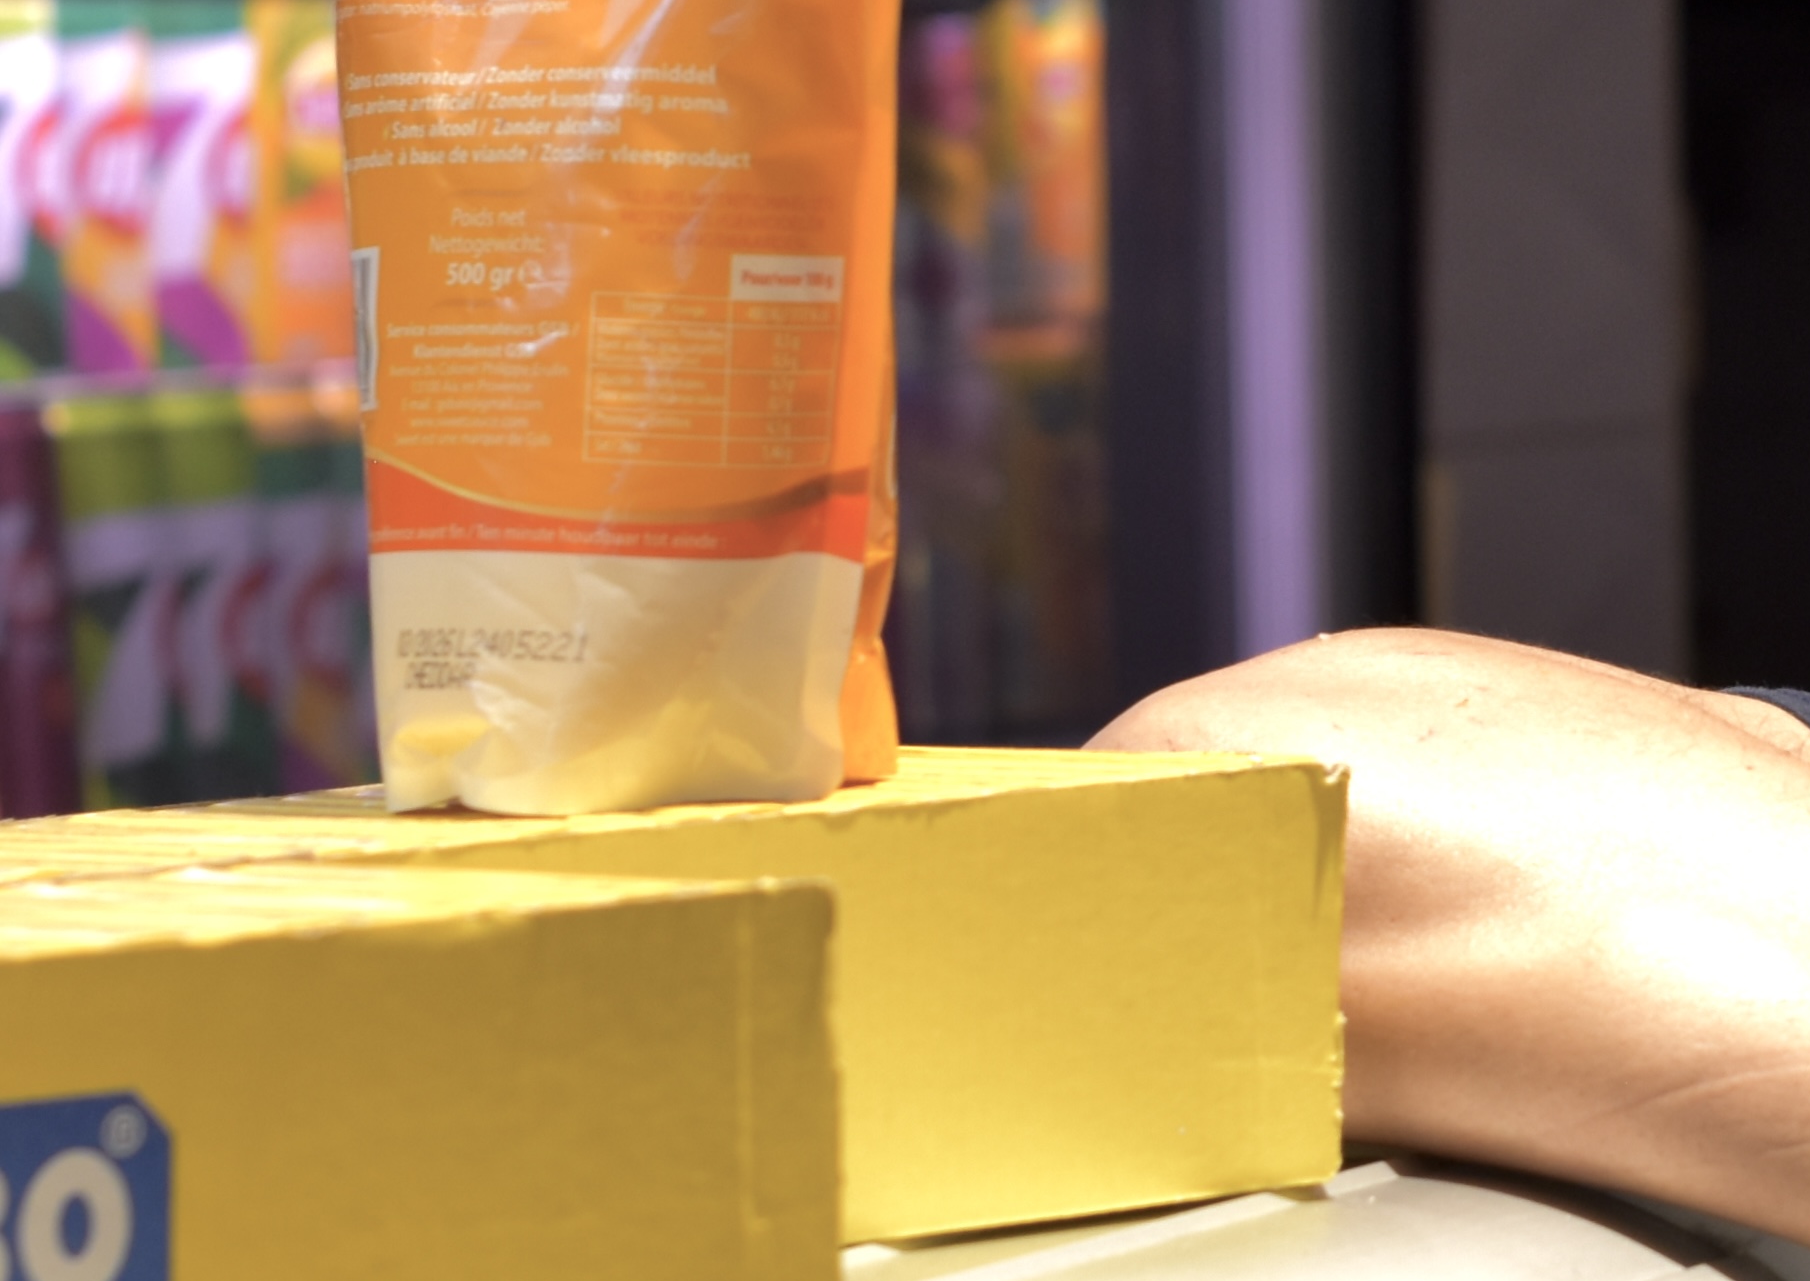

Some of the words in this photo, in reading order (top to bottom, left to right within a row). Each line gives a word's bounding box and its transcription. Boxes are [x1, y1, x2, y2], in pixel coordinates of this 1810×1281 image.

[374, 71, 476, 87] conservateur
[485, 65, 545, 84] Zonder
[487, 90, 546, 110] Zonder
[391, 120, 425, 140] Sans
[428, 118, 477, 137] alcool
[492, 116, 551, 136] Zonder
[410, 147, 446, 165] base
[448, 145, 469, 164] de
[471, 145, 528, 163] viande
[446, 262, 486, 286] 500
